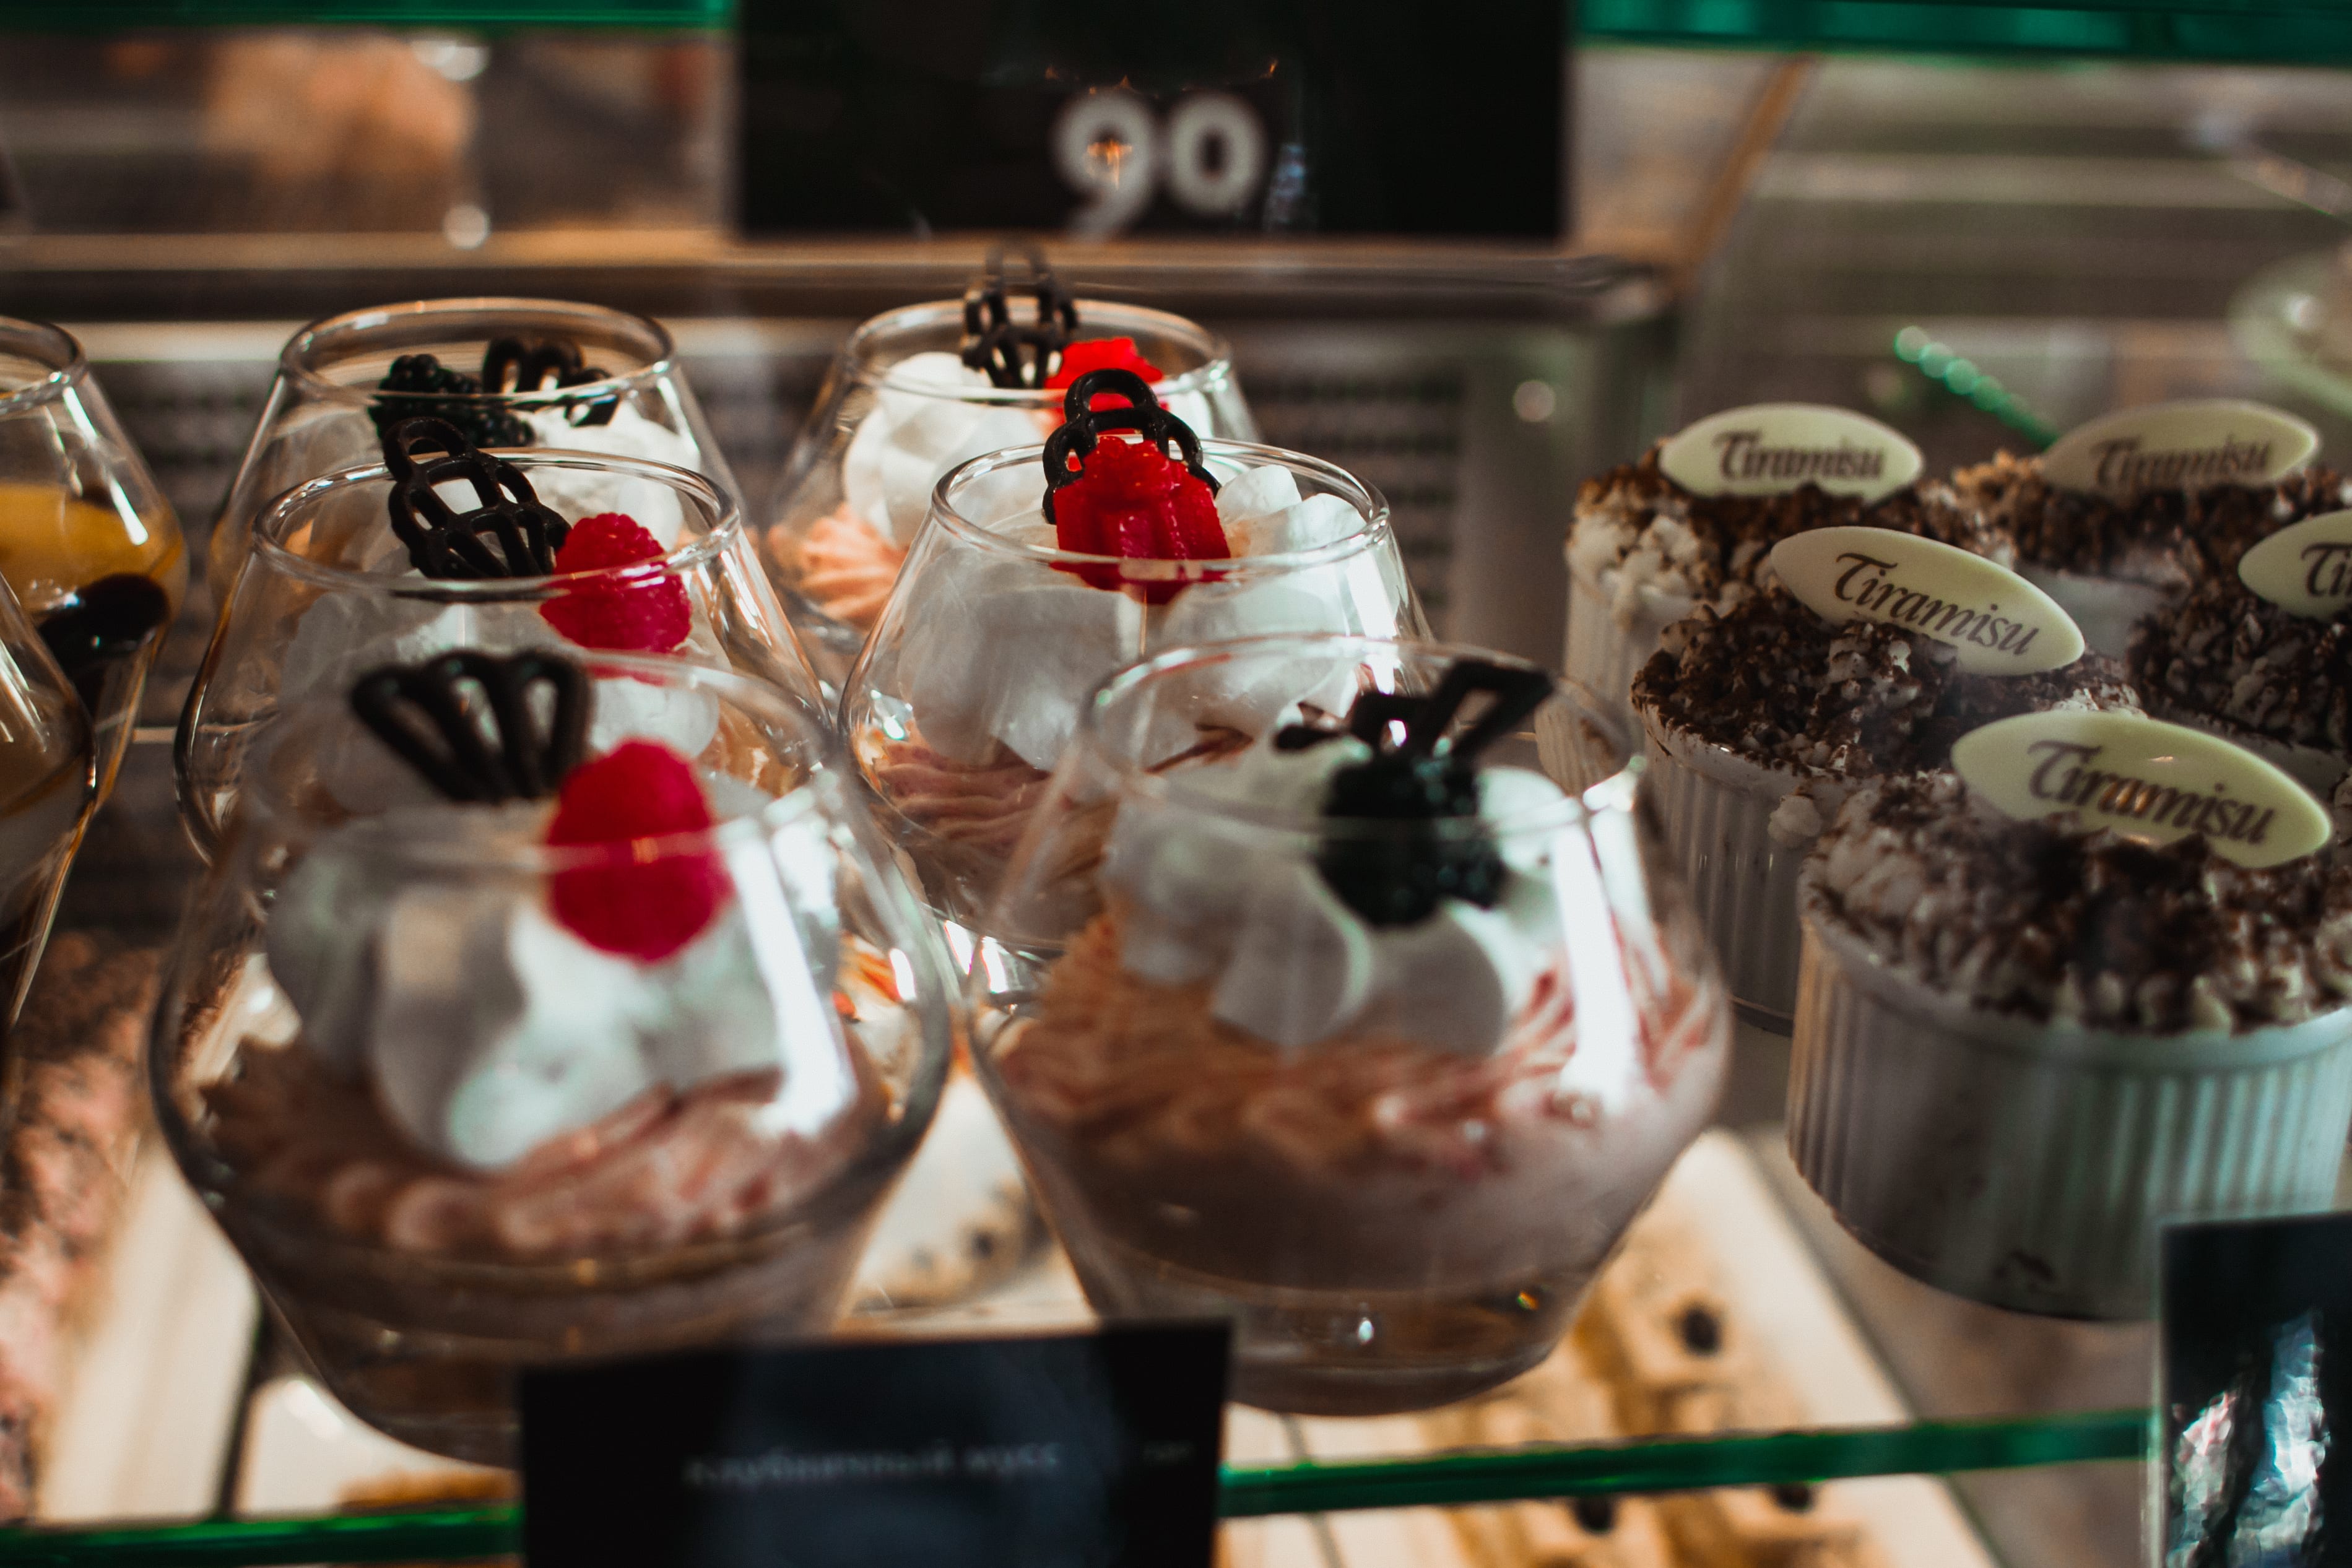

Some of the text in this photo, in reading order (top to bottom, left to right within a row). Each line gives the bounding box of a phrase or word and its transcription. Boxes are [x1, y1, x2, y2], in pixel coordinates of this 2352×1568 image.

[1054, 92, 1263, 243] 90
[1712, 428, 1883, 480] Tiramisu
[1834, 552, 2039, 655] Tiramisu
[2301, 542, 2352, 597] Ti
[2027, 740, 2275, 845] Tiramisu
